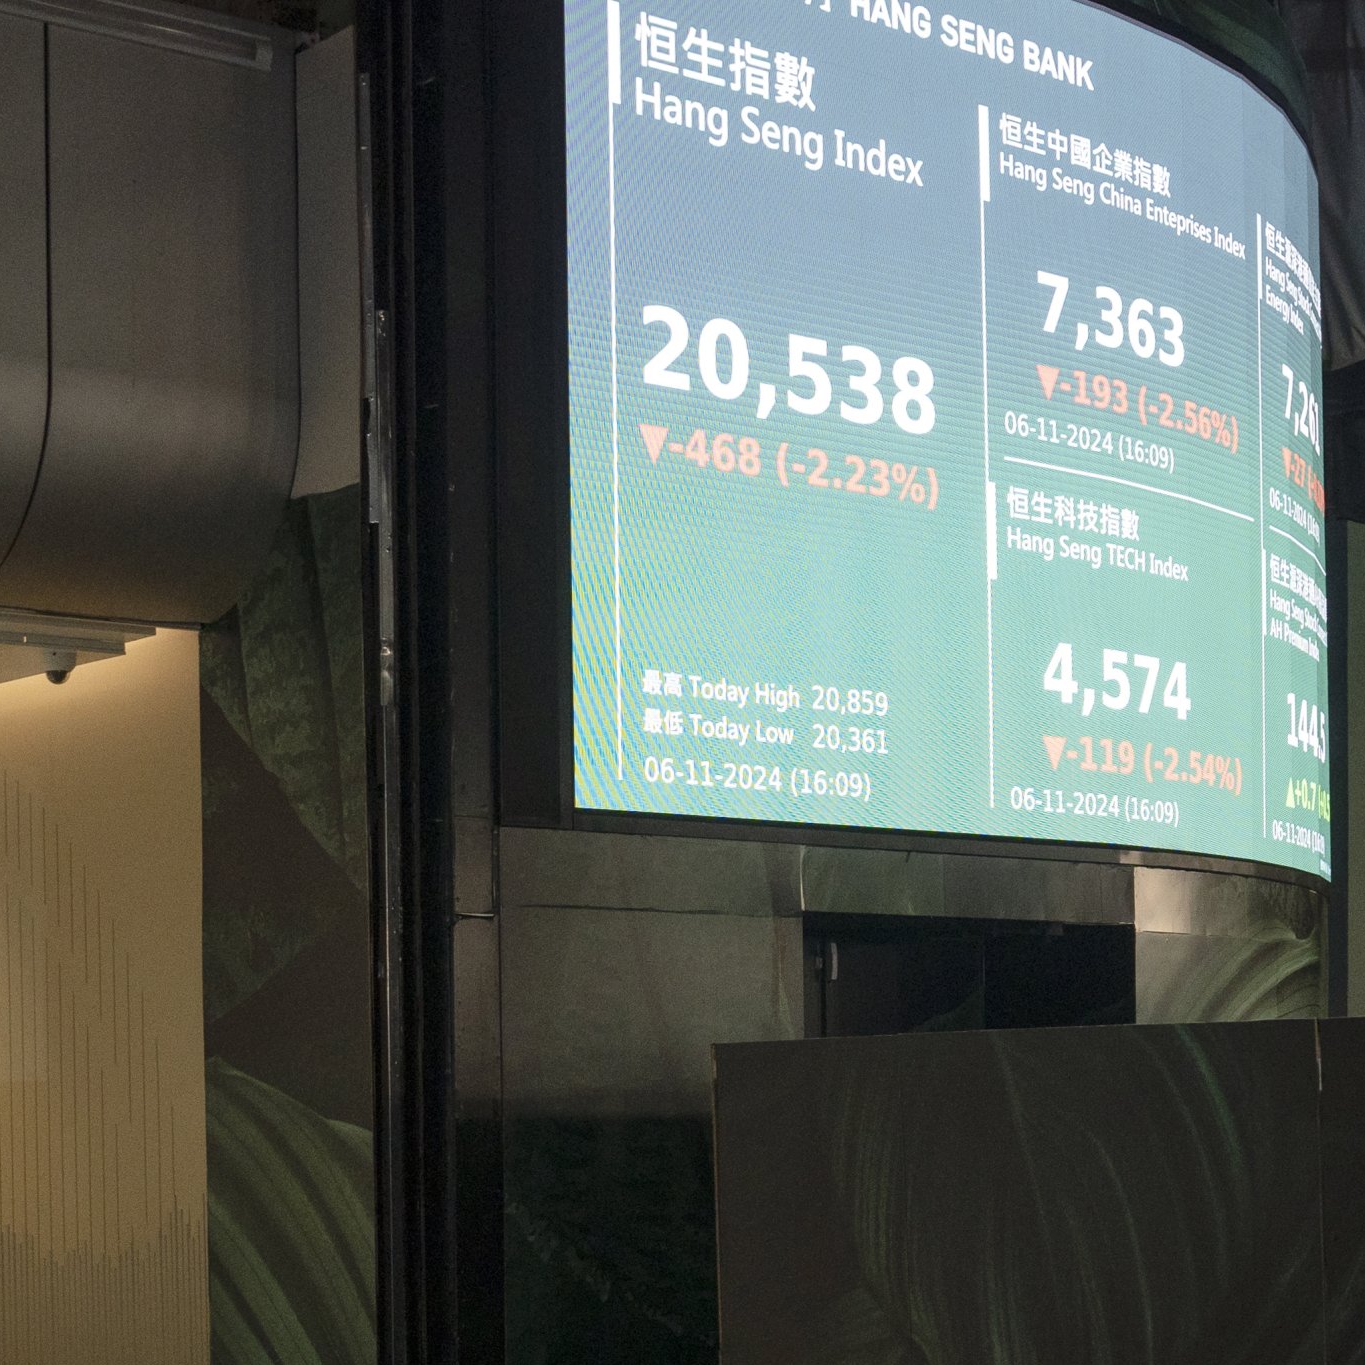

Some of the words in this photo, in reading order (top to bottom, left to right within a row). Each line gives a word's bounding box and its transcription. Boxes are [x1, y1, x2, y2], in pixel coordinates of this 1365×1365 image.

[635, 11, 816, 111] 恒生指數
[941, 20, 1014, 64] SENG
[1023, 40, 1095, 91] BANK
[635, 77, 729, 146] Hang
[741, 106, 824, 170] Seng
[835, 129, 924, 187] Index
[999, 112, 1171, 198] 恒生中國企業指數
[1000, 152, 1047, 191] Hang
[1053, 168, 1095, 205] Seng
[1100, 181, 1142, 216] China
[1146, 198, 1212, 244] Enteprises
[1214, 226, 1246, 260] Index
[1265, 256, 1285, 293] Hang
[1037, 270, 1185, 367] 7,363
[642, 305, 936, 434] 20,538
[1005, 411, 1114, 454] 06-11-2024
[1119, 434, 1175, 474] (16:09)
[1138, 385, 1239, 455] (-2.56%)
[776, 442, 940, 511] (-2.23%)
[1006, 486, 1140, 541] 恒生科技指數
[1007, 526, 1054, 561] Hang
[1059, 535, 1102, 569] Seng
[1107, 543, 1146, 572] TECH
[1149, 553, 1189, 581] Index
[1269, 588, 1291, 621] Hang
[690, 675, 750, 708] Today
[755, 682, 800, 712] High
[812, 684, 889, 717] 20,859
[1043, 642, 1192, 720] 4,574
[690, 713, 750, 746] Today
[756, 720, 795, 745] Low
[812, 724, 889, 754] 20,361
[644, 756, 782, 791] 06-11-2024
[790, 768, 871, 802] (16:09)
[1144, 742, 1242, 795] (-2.54%)
[1010, 785, 1120, 817] 06-11-2024
[1125, 796, 1179, 828] (16:09)
